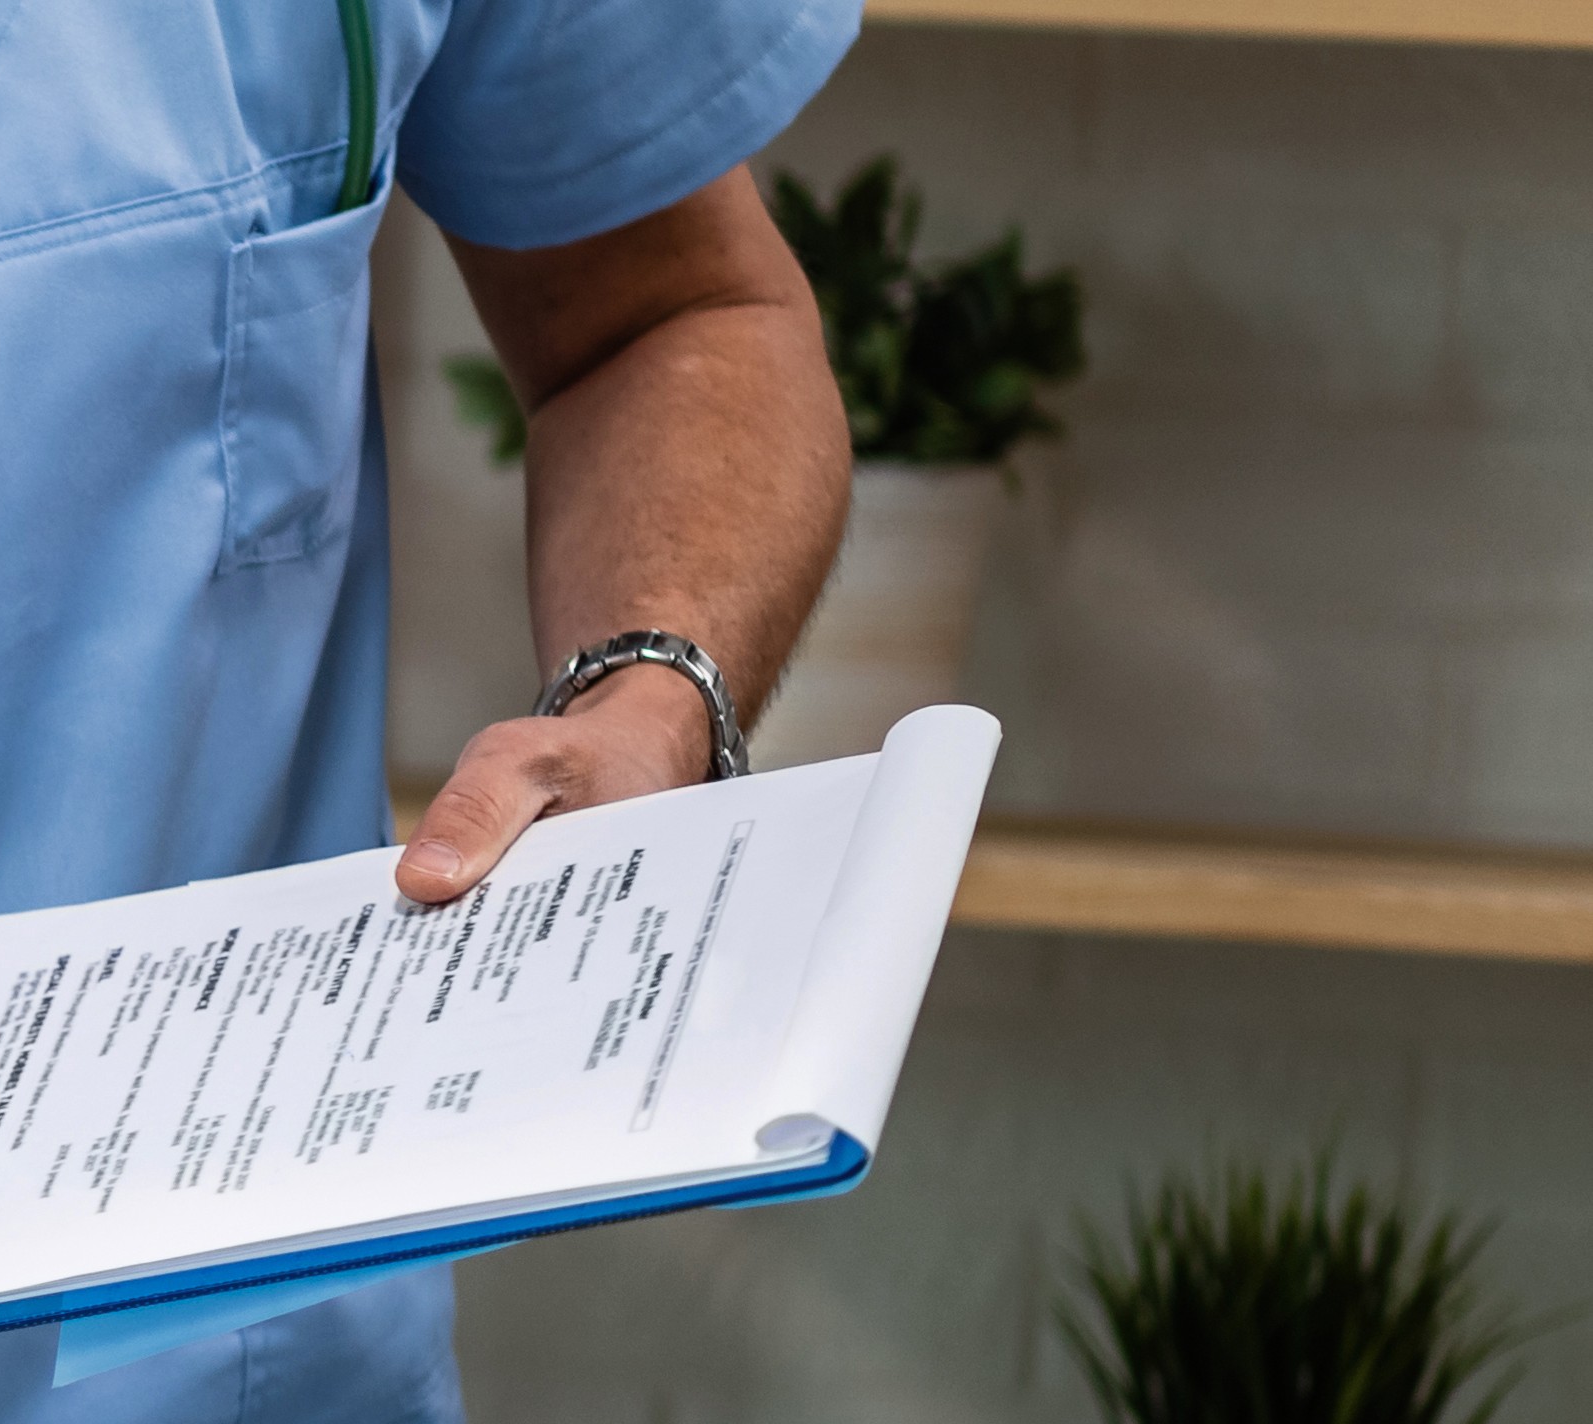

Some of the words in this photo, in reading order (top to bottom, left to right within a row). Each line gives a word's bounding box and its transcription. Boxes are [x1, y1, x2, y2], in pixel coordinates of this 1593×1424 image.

[614, 848, 645, 901] ACADEMICS
[220, 927, 240, 953] WORK
[344, 903, 375, 954] COMMUNITY
[44, 954, 70, 994] SPECIAL
[97, 946, 123, 982] TRAVEL
[194, 955, 229, 1011] EXPERIENCE
[322, 957, 352, 1005] ACTIVITIES
[648, 952, 673, 989] Roberta
[425, 974, 455, 1023] ACTIVITIES
[638, 989, 660, 1020] Timber
[22, 996, 54, 1047] INTERESTS,
[3, 1050, 30, 1091] HOBBIES,
